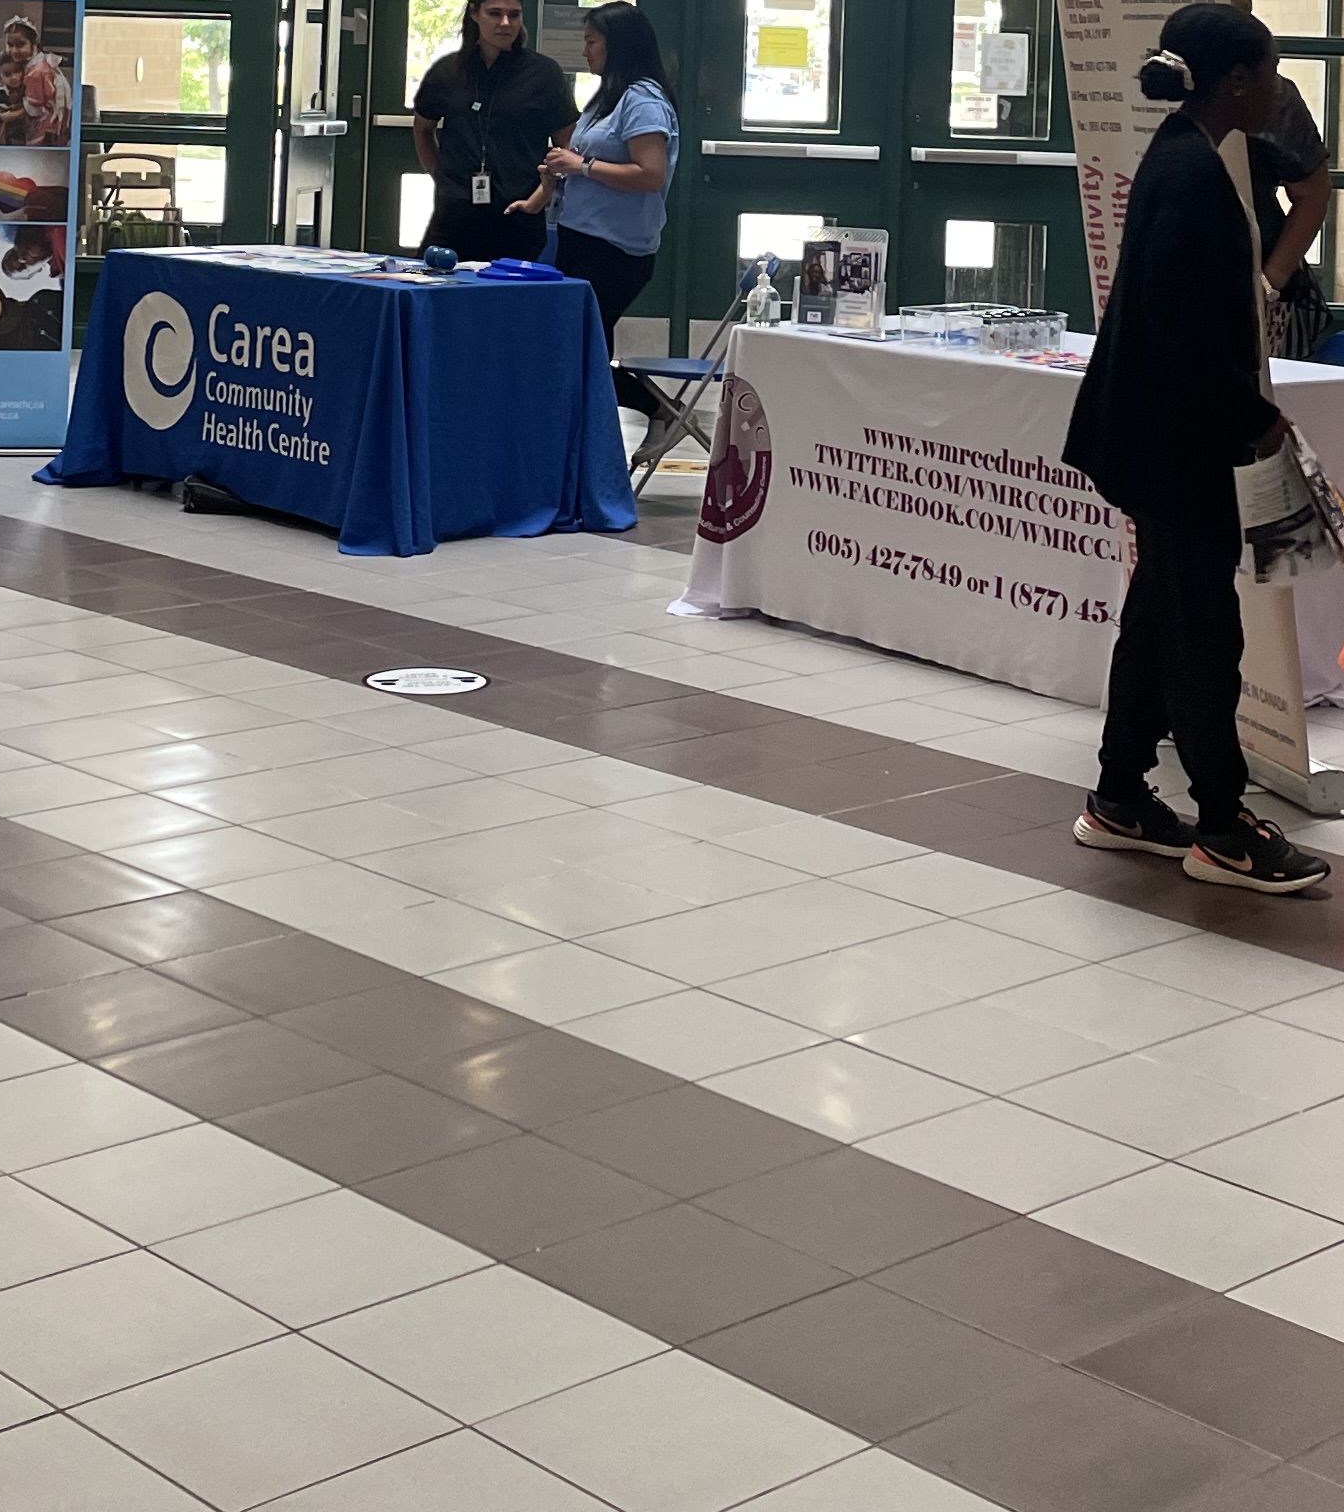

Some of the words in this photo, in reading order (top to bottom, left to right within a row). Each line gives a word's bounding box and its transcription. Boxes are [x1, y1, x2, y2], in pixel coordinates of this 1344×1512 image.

[1082, 155, 1110, 328] ensitivity,
[208, 303, 315, 378] Carea
[205, 371, 313, 428] Community
[202, 411, 263, 452] Health
[267, 423, 331, 466] Centre
[863, 426, 1101, 494] www.wmrccdurham.
[807, 529, 860, 567] (905)
[865, 544, 962, 589] 427-7849
[967, 575, 989, 595] or
[1010, 581, 1069, 621] (877)
